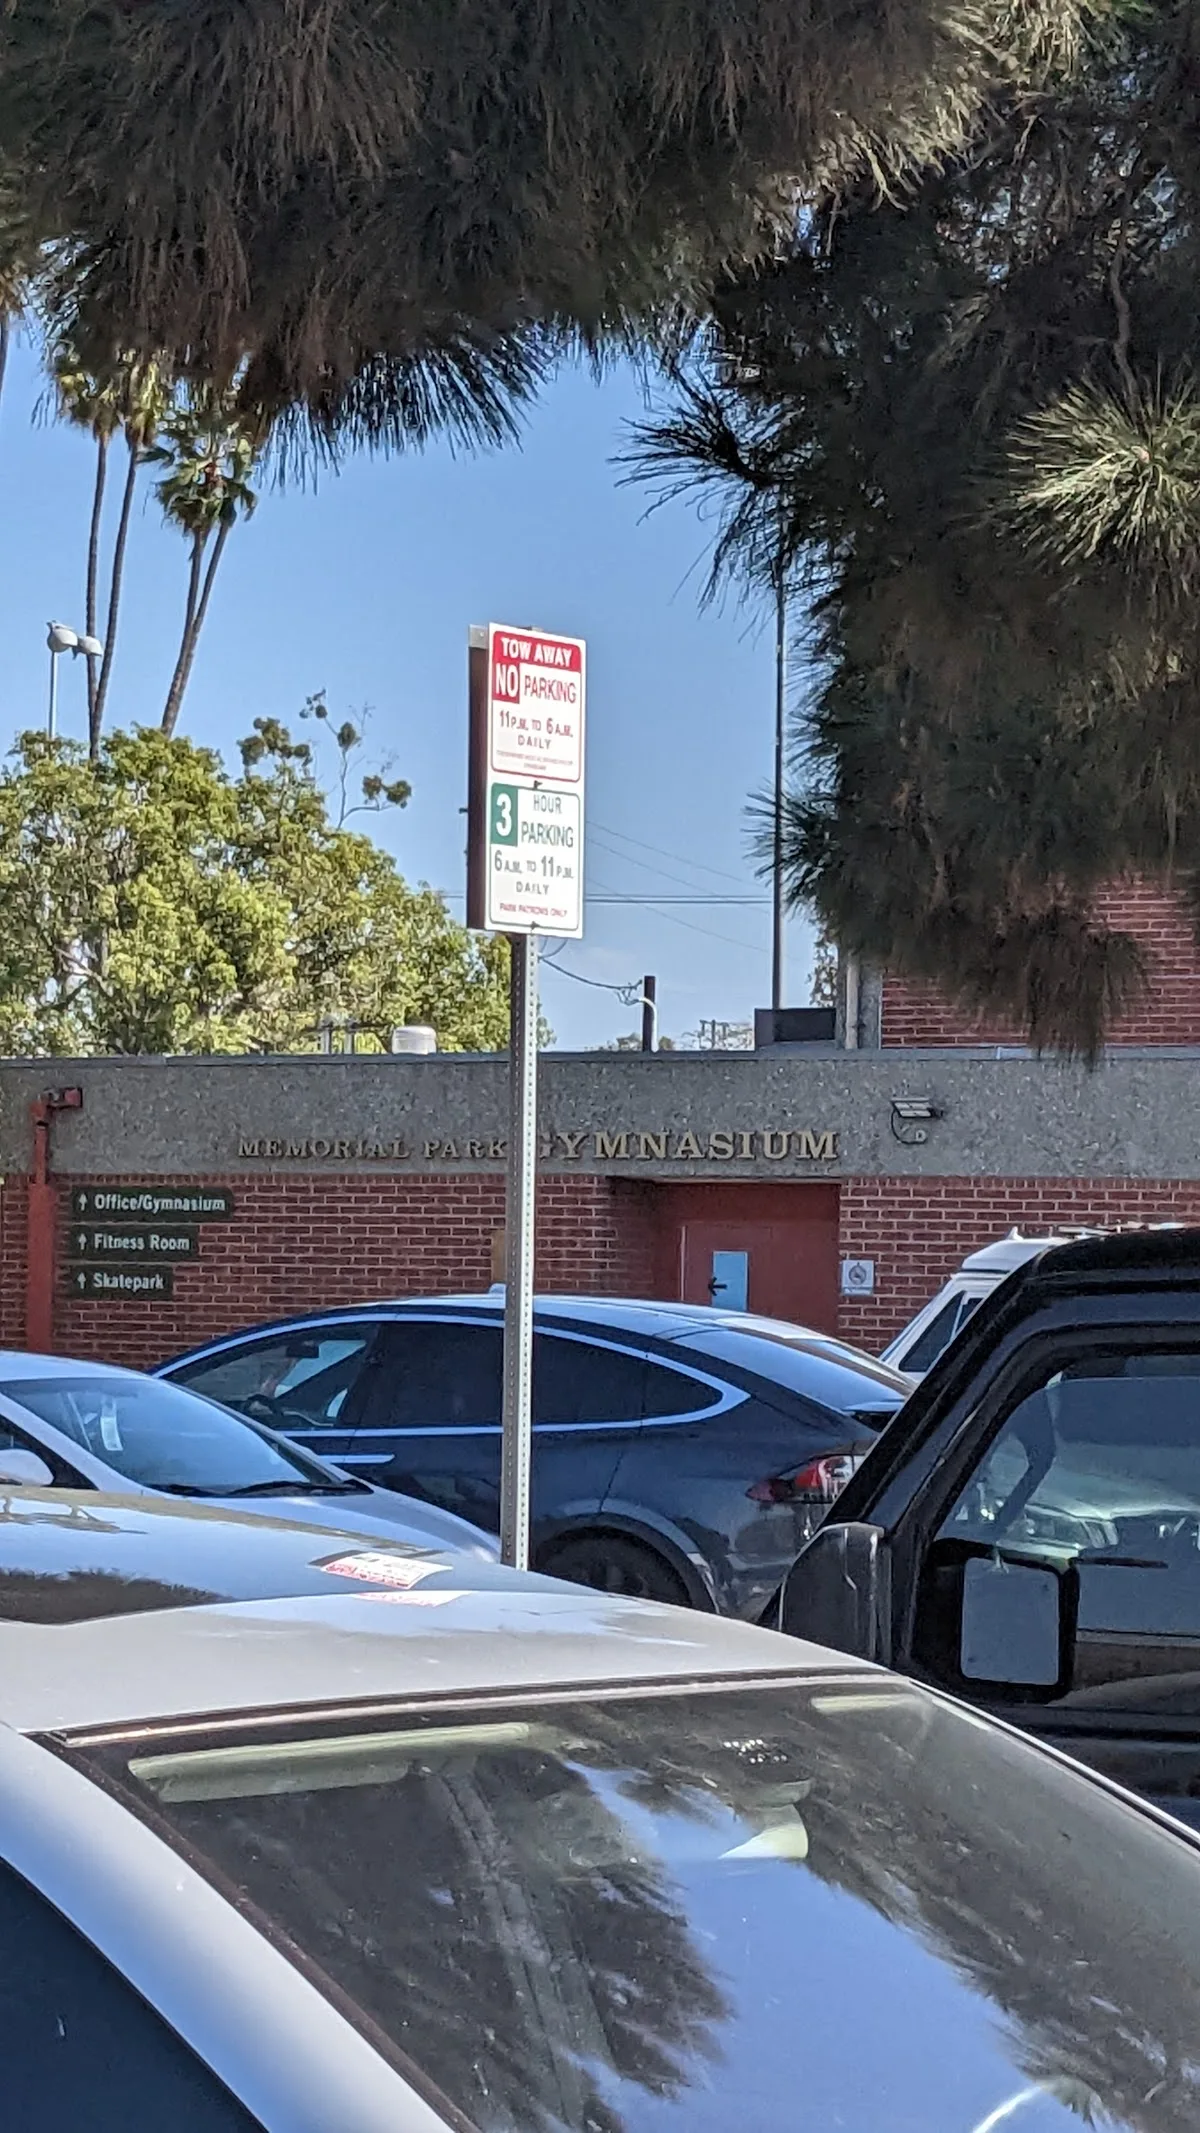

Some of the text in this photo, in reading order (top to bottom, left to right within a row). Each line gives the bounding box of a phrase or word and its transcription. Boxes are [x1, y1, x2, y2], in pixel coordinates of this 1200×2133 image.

[501, 637, 572, 667] TOW AWAY
[495, 662, 577, 704] NO PARKING
[517, 734, 552, 749] DAILY
[495, 792, 563, 837] 3 HOUR
[521, 821, 574, 848] PARKING
[516, 881, 550, 895] DAILY
[238, 1138, 410, 1159] MEMORIAL
[423, 1139, 509, 1160] PARK
[94, 1233, 190, 1251] Fitness Room
[93, 1272, 165, 1293] Skatepark
